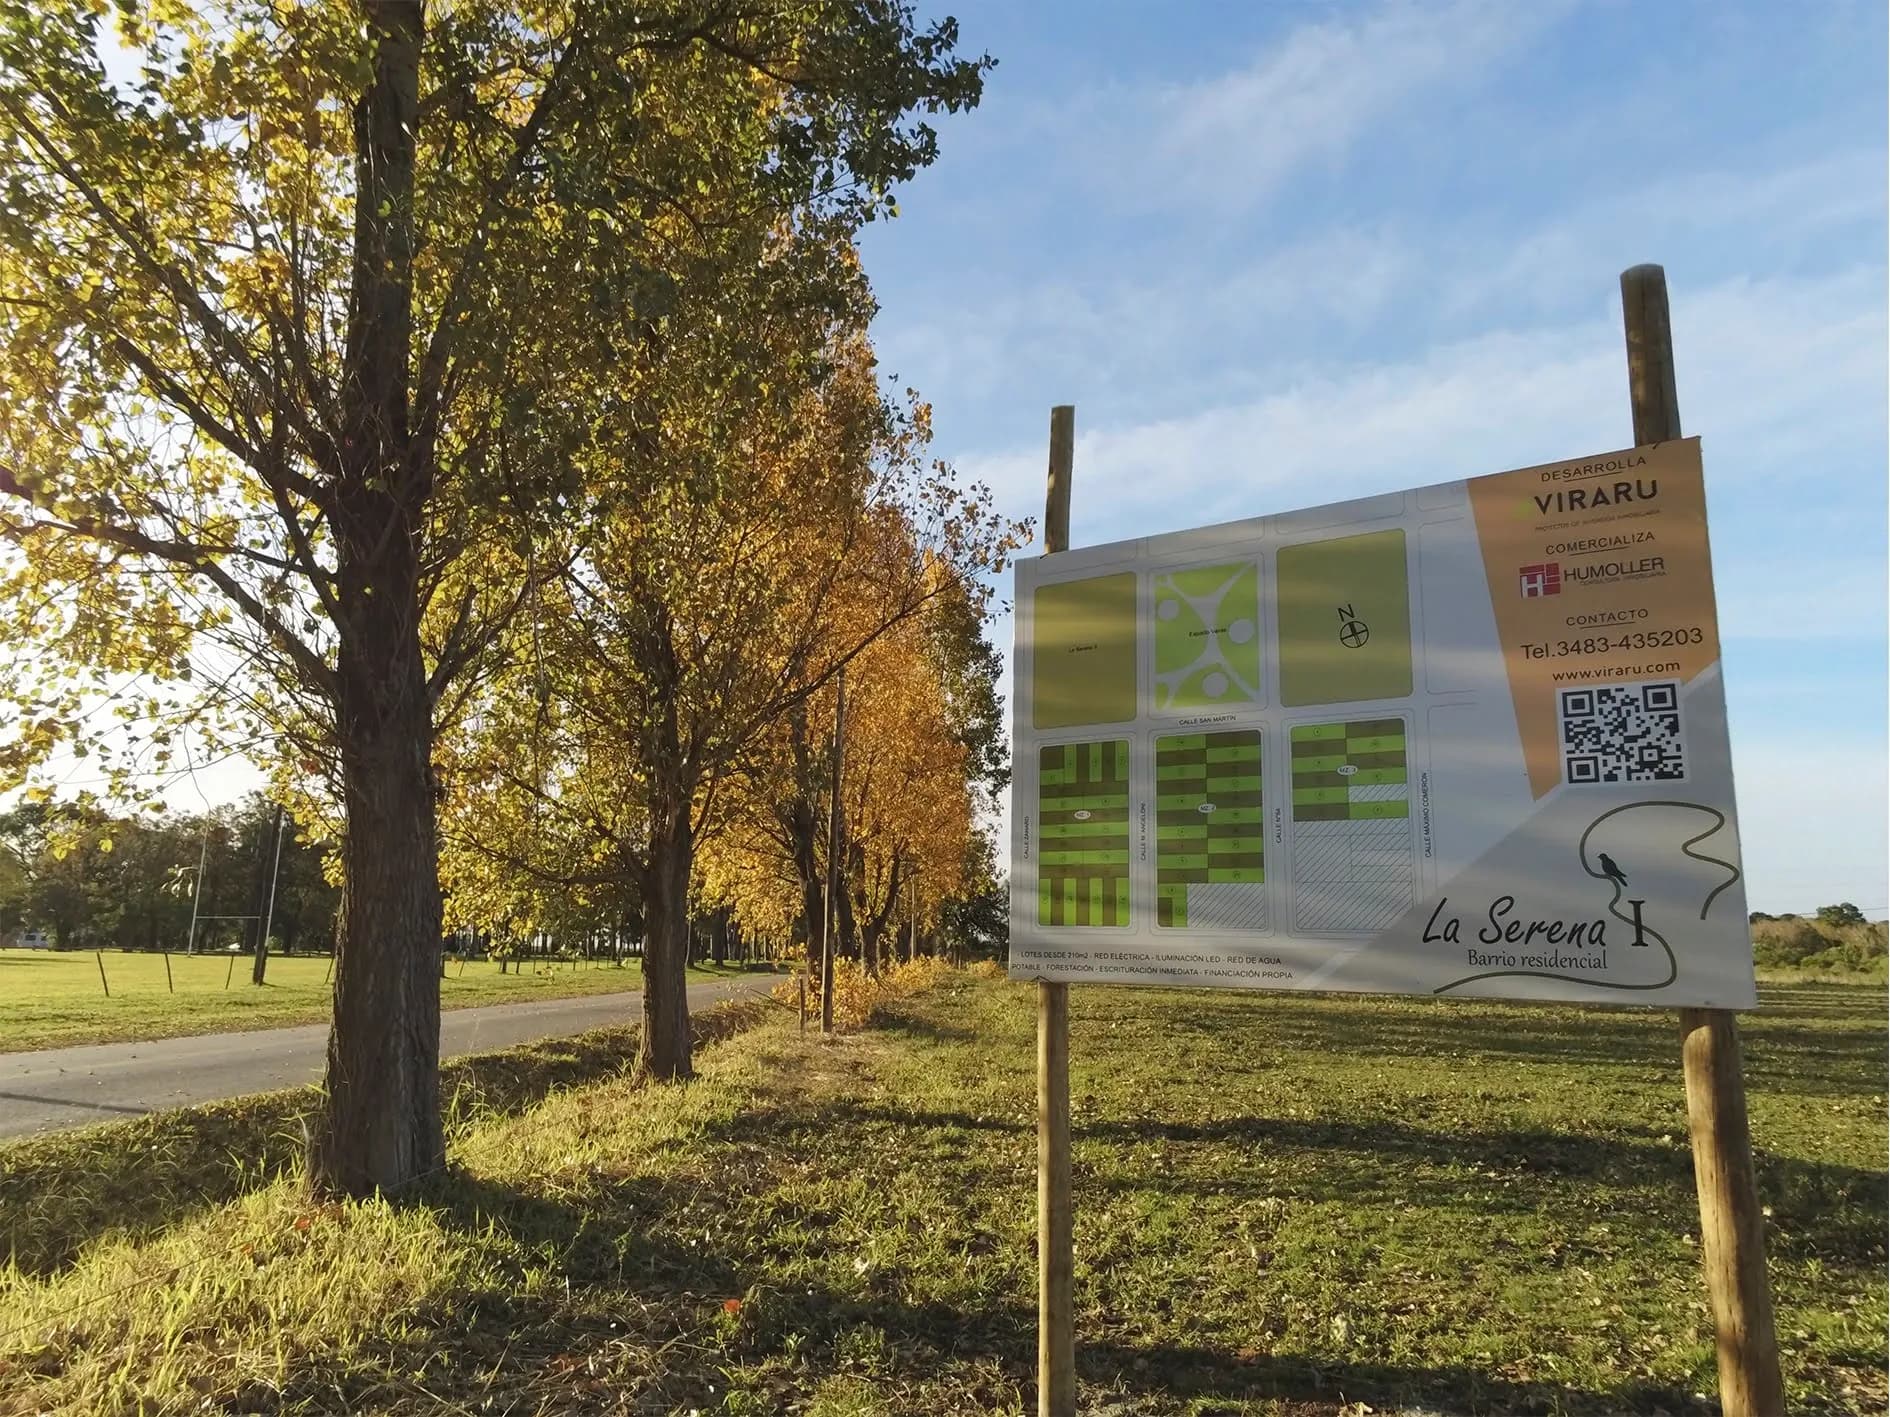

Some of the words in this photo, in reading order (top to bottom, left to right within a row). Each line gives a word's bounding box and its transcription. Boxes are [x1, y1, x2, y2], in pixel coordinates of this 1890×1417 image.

[1541, 456, 1647, 482] DESARROLLA
[1533, 479, 1658, 515] VIRARU
[1545, 531, 1656, 555] COMERCIALIZA
[1563, 557, 1665, 582] HUMOLLER
[1338, 603, 1355, 622] N
[1566, 608, 1649, 626] CONTACTO
[1520, 627, 1704, 660] Tel.3483-435203
[1552, 661, 1681, 682] www.viraru.com
[1178, 718, 1198, 726] CALLE
[1424, 836, 1432, 858] CALLE
[1422, 897, 1460, 943] La
[1478, 895, 1607, 949] Serena
[1627, 900, 1649, 947] I
[1020, 951, 1042, 959] LOTES
[1043, 951, 1066, 959] DESDE
[1094, 952, 1109, 960] RED
[1205, 955, 1221, 963] LED
[1226, 955, 1244, 964] RED
[1245, 956, 1257, 964] DE
[1258, 957, 1282, 965] AGUA
[1467, 949, 1517, 968] Barrio
[1520, 949, 1609, 970] residencial
[1011, 963, 1041, 971] POTABLE
[1160, 967, 1199, 976] INMEDIATA
[1262, 971, 1293, 979] PROPIA
